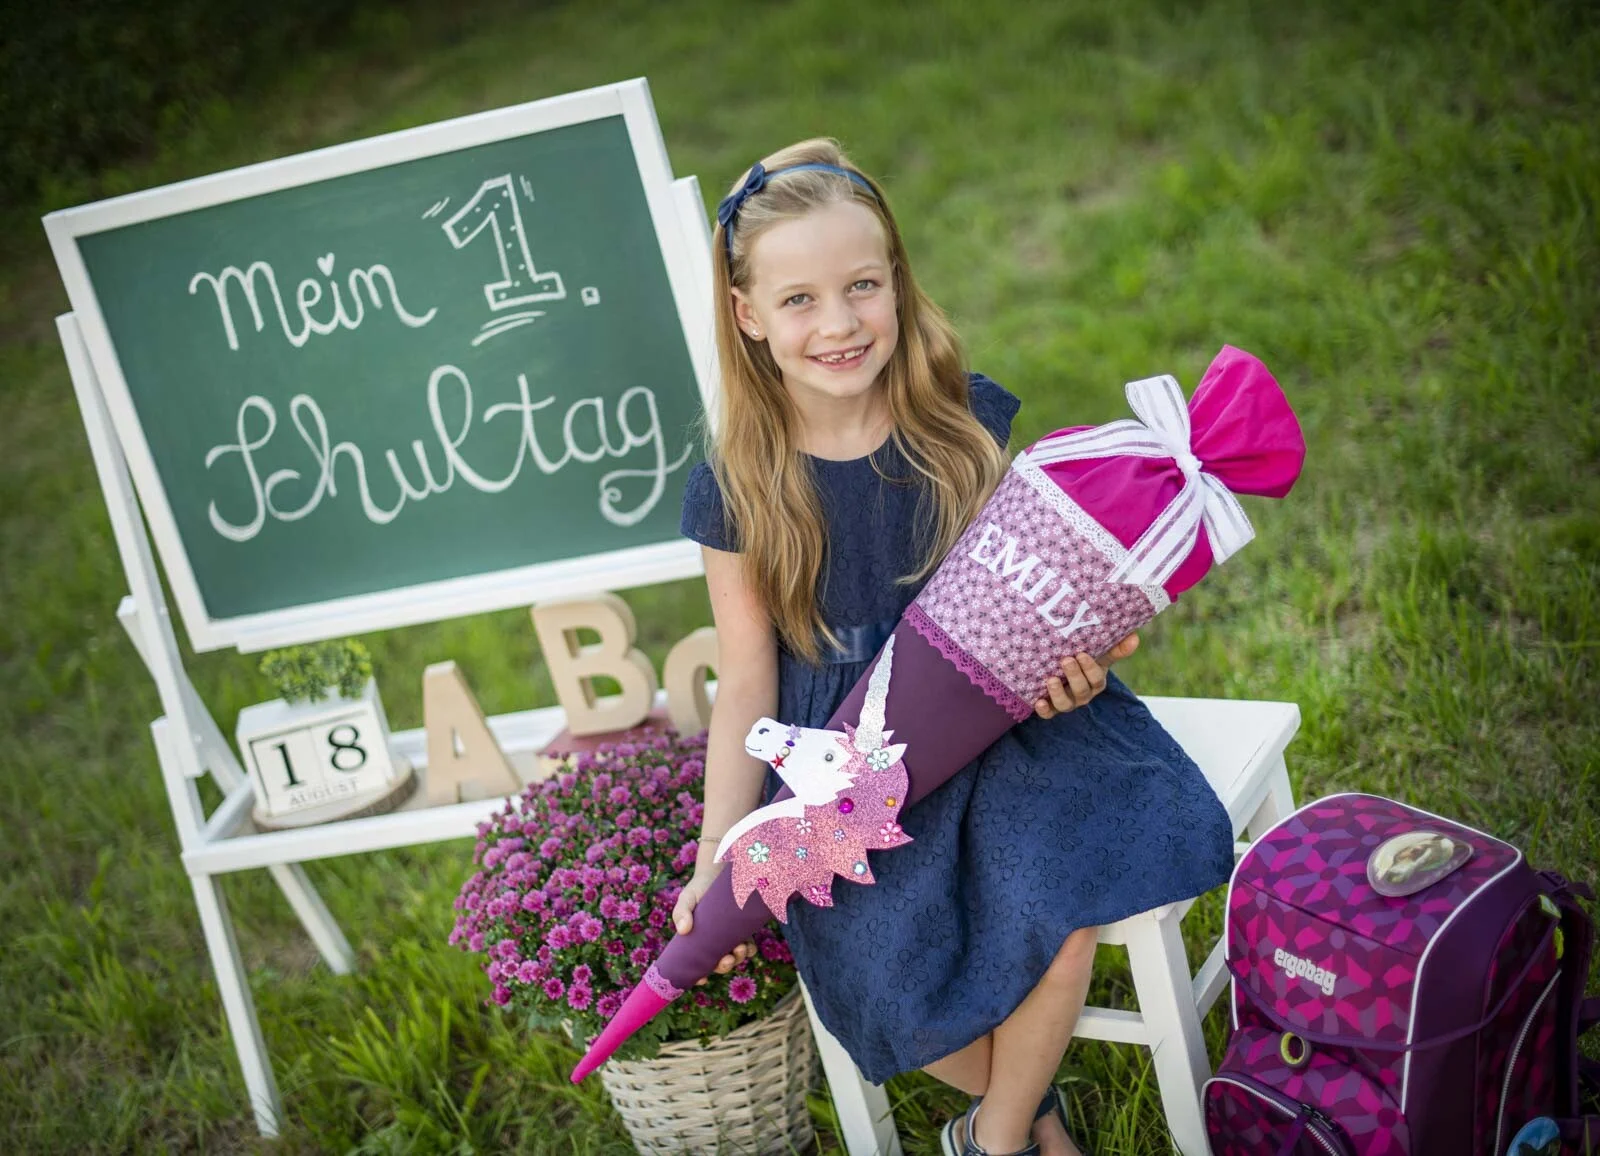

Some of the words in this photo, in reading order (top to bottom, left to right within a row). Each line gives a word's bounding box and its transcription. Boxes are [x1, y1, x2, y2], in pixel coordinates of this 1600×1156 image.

[188, 252, 438, 351] Mein
[442, 173, 601, 312] 1.
[205, 364, 693, 542] Schultag
[967, 521, 1102, 639] EMILY
[272, 722, 368, 791] 18
[288, 775, 361, 808] AUGUST
[1273, 947, 1337, 997] ergobag
